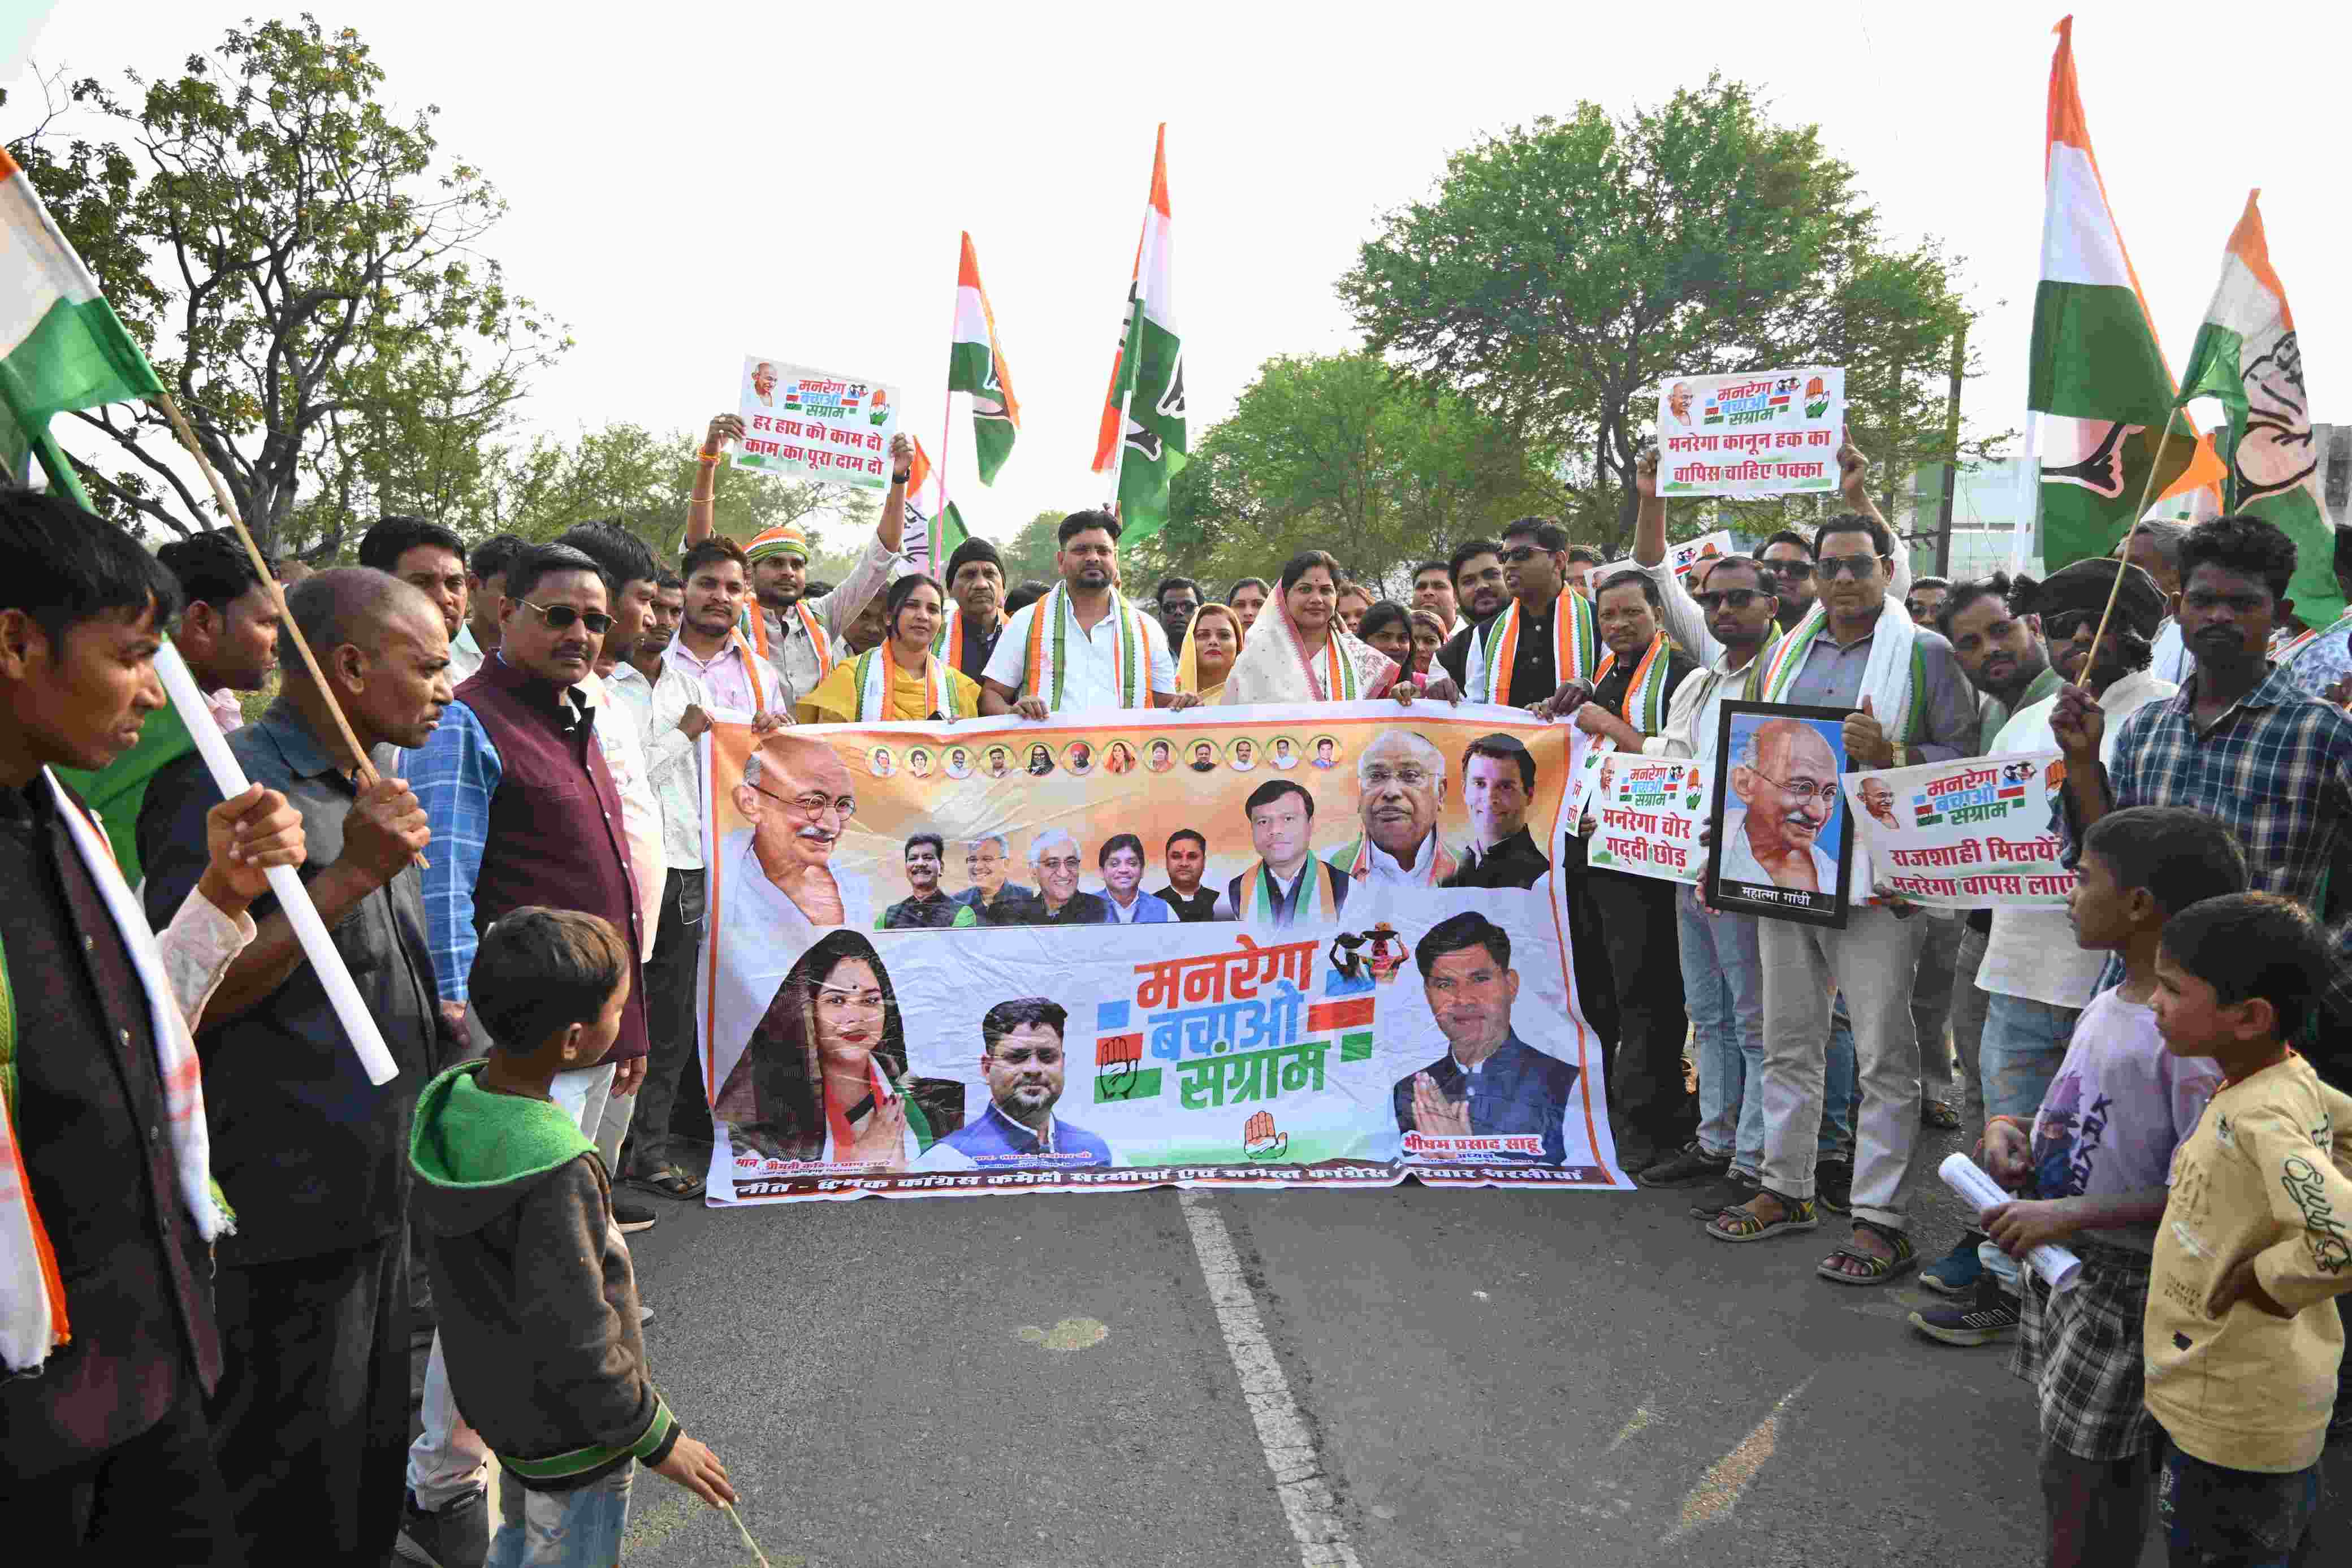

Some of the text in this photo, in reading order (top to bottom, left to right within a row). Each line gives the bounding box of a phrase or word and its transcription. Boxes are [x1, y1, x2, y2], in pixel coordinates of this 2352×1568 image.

[798, 379, 847, 395] मनरेगा
[1717, 380, 1774, 401] मनरेगा
[753, 415, 884, 452] हर हाथ को काम दो
[1667, 430, 1832, 455] मनरेगा कानून हक का
[745, 438, 884, 475] काम का पूरा दाम दो
[1674, 460, 1824, 482] वापिस चाहिए पक्का
[1629, 764, 1668, 781] मनरेगा
[1925, 768, 1999, 798] मनरेगा
[1934, 785, 1996, 812] बचाओ
[1602, 806, 1658, 834] मनरेगा
[1662, 812, 1692, 840] चोर
[1889, 838, 1982, 867] राजशाही
[1742, 886, 1811, 906] महात्मा गांधी
[1890, 873, 1957, 896] मनरेगा
[1960, 874, 2022, 896] वापस
[1134, 934, 1320, 1010] मनरेगा
[1148, 978, 1305, 1061] बचाओ
[1177, 1040, 1331, 1110] संग्राम
[1454, 1138, 1501, 1151] प्रसाद
[1506, 1137, 1541, 1154] साहू
